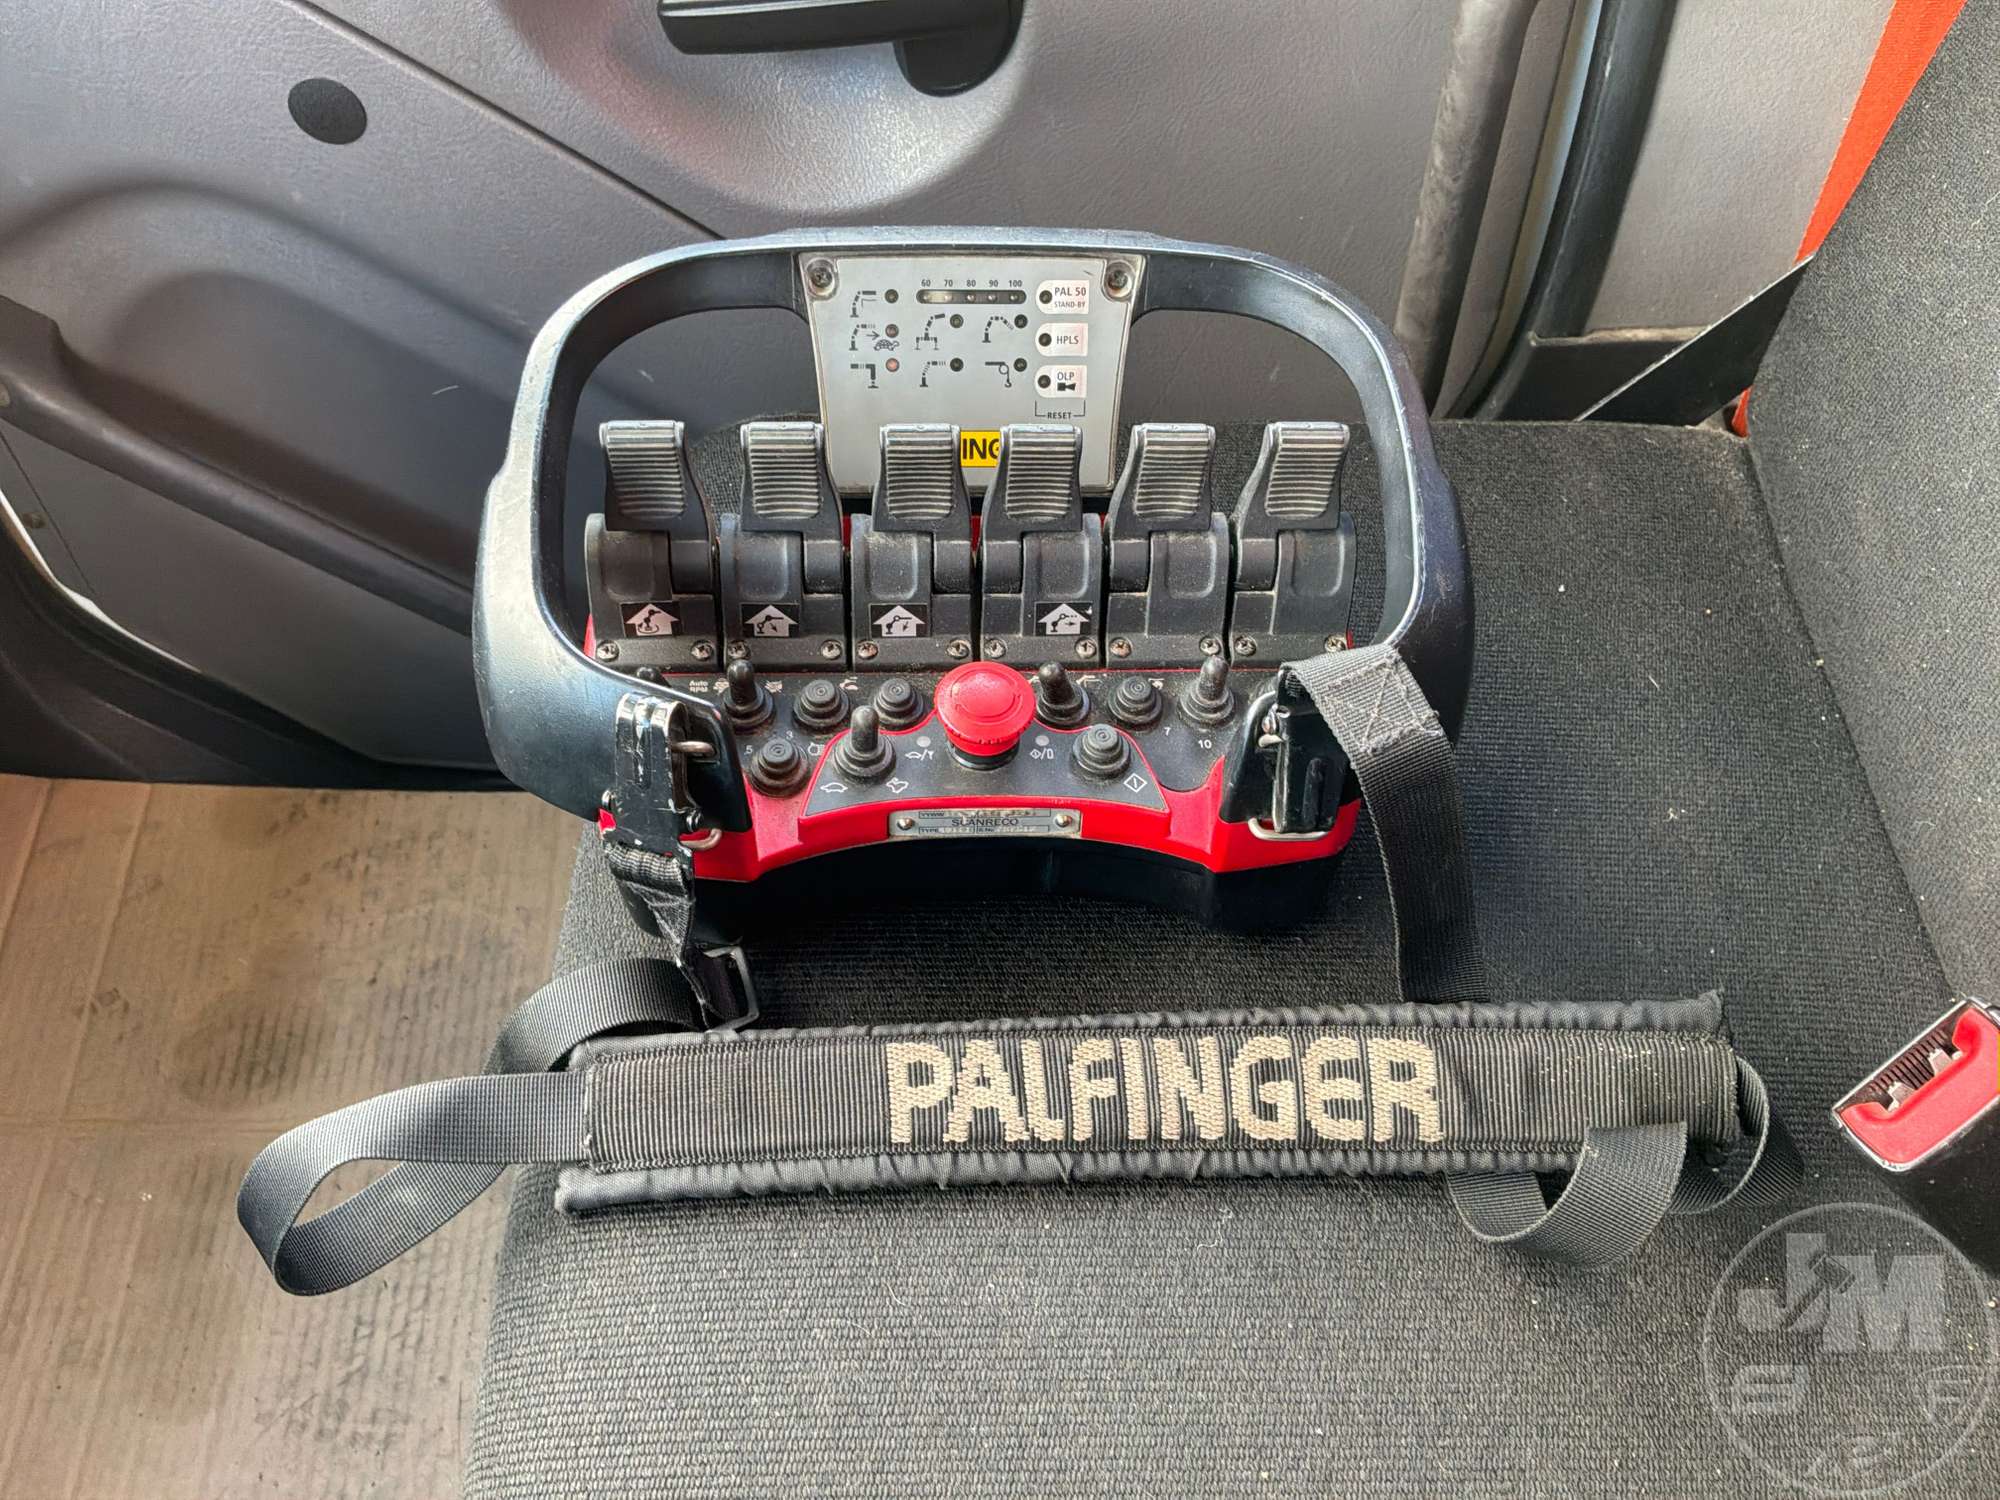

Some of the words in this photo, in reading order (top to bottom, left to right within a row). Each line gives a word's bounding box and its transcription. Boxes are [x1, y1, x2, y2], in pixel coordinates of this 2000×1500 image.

[921, 279, 931, 288] 60
[944, 279, 954, 288] 70
[966, 279, 976, 288] 80
[988, 279, 999, 288] 90
[1008, 279, 1023, 288] 100
[1054, 287, 1073, 297] PAL
[1075, 286, 1087, 297] 50
[1056, 335, 1080, 345] HPLS
[1056, 371, 1075, 381] OLP
[1047, 412, 1072, 420] RESET
[1164, 727, 1171, 736] 7
[1198, 739, 1212, 749] 10
[951, 817, 1019, 827] SCANRECO
[886, 1035, 1444, 1144] PALFINGER
